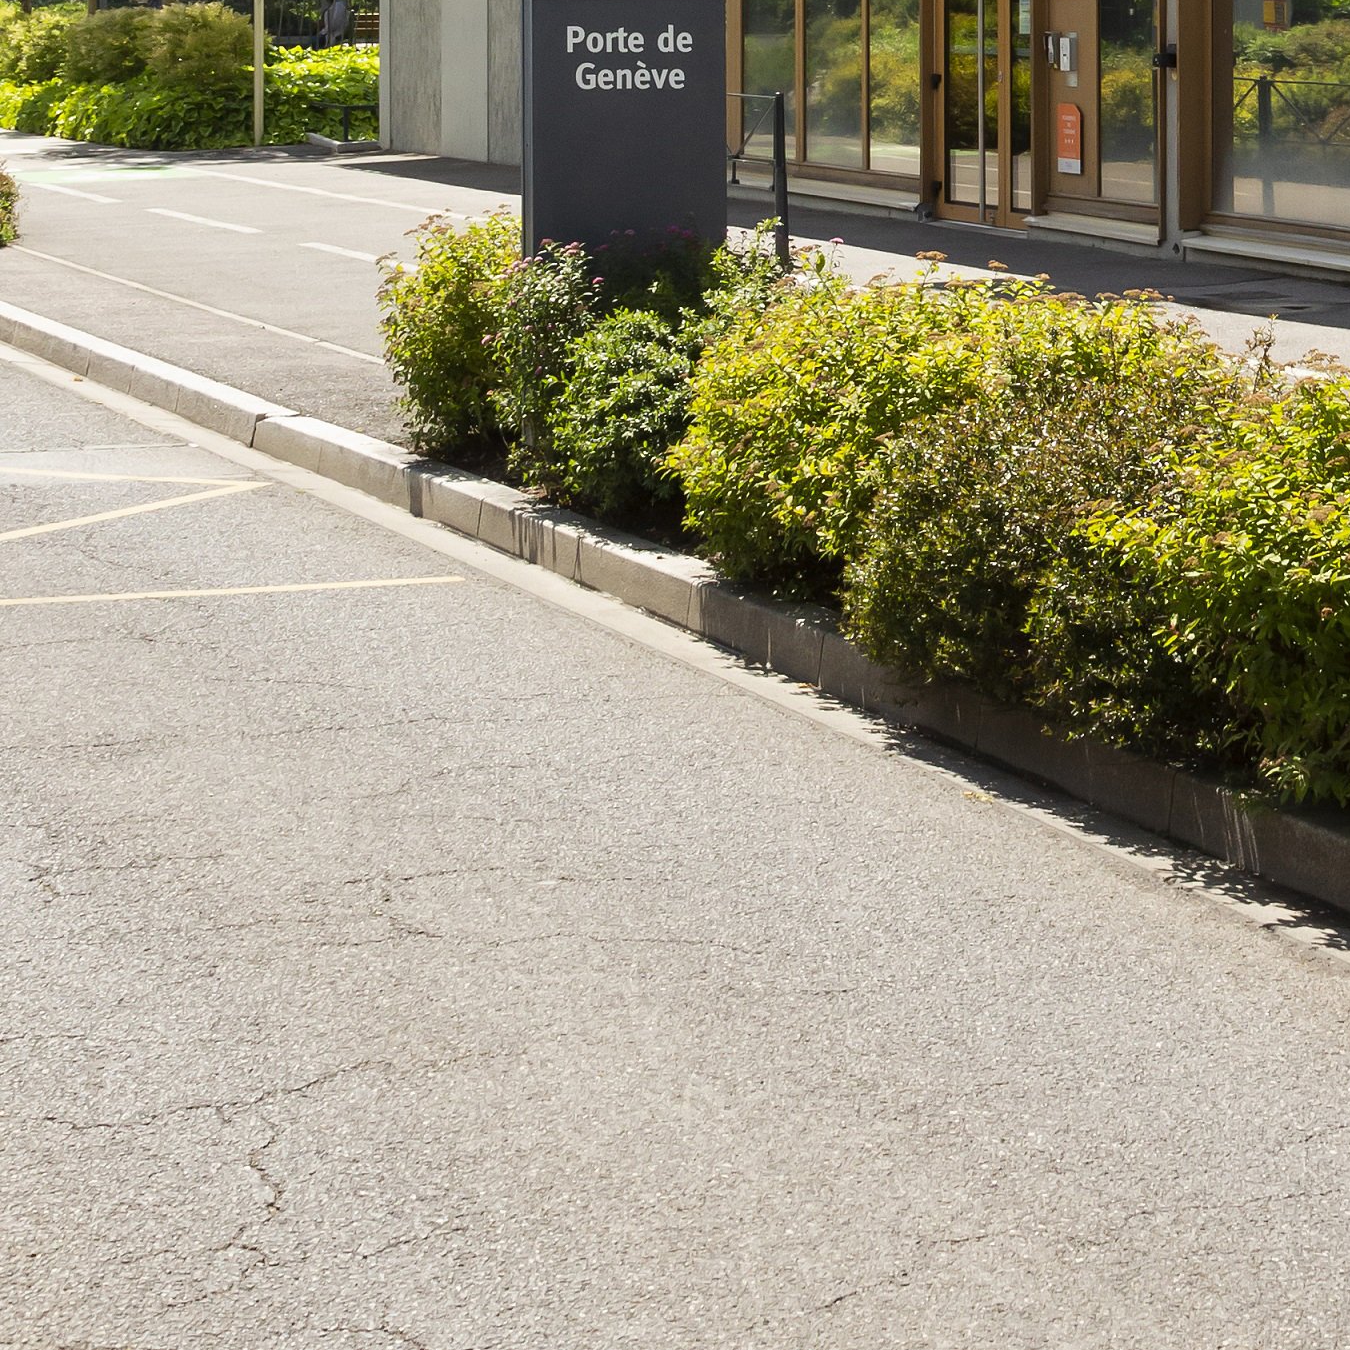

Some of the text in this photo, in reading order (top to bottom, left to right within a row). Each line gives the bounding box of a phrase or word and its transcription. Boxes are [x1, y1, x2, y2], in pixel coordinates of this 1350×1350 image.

[566, 24, 693, 53] Porte de
[575, 60, 686, 90] Genève
